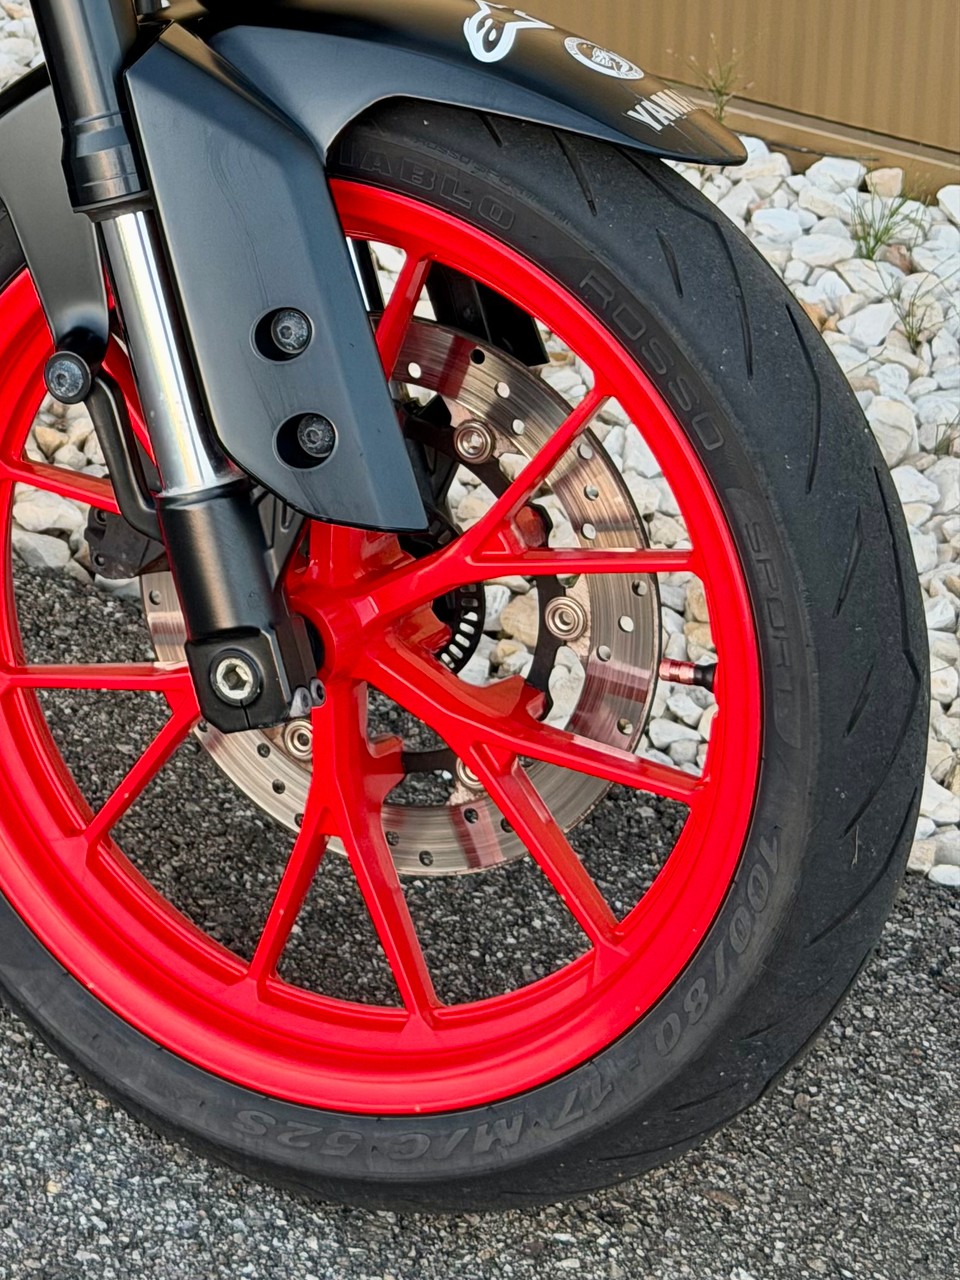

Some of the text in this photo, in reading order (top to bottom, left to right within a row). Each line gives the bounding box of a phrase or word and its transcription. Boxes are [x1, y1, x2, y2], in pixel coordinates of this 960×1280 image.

[579, 270, 725, 451] ROSSO
[744, 521, 794, 699] SPORT
[235, 1109, 364, 1158] 52S
[386, 1113, 525, 1162] M/C
